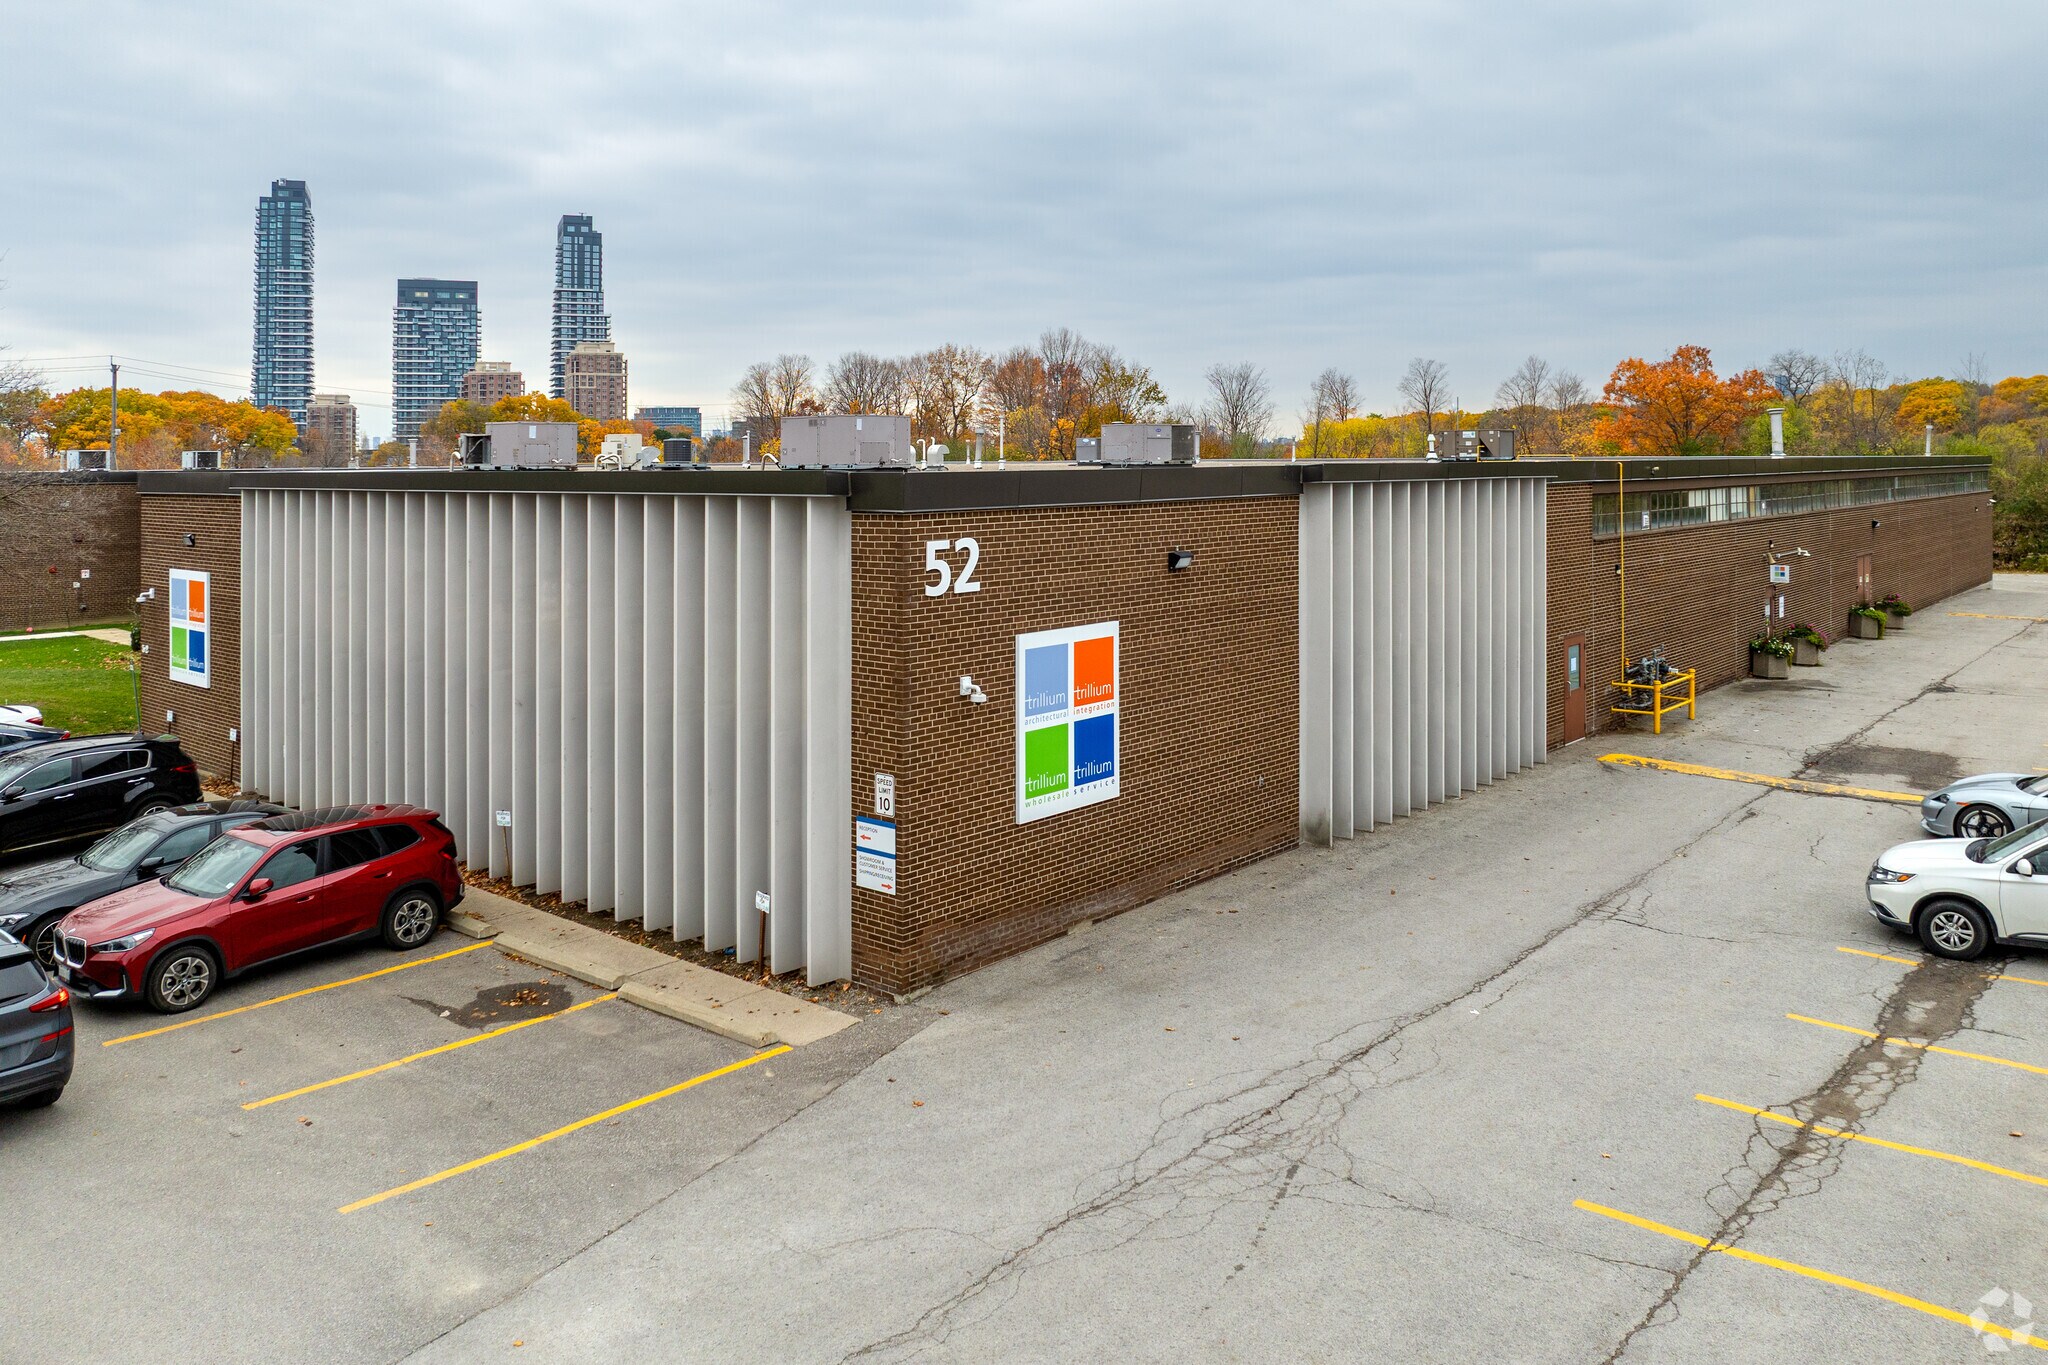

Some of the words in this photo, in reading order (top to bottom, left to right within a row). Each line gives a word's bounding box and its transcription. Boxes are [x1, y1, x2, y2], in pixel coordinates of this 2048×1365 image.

[925, 537, 981, 597] 52
[1073, 682, 1112, 701] trillium
[1025, 691, 1066, 710] trillium
[1073, 701, 1115, 716] integration
[1024, 710, 1069, 726] architectural
[1074, 760, 1112, 780] trillium
[877, 778, 892, 786] SPEED
[1025, 771, 1067, 792] trillium
[1074, 779, 1115, 795] service
[879, 786, 891, 795] LIMIT
[879, 796, 890, 811] 10
[1025, 791, 1069, 807] wholesale
[859, 825, 878, 834] RECEPTION
[859, 861, 878, 870] CUSTOMER
[879, 865, 892, 873] SERVICE
